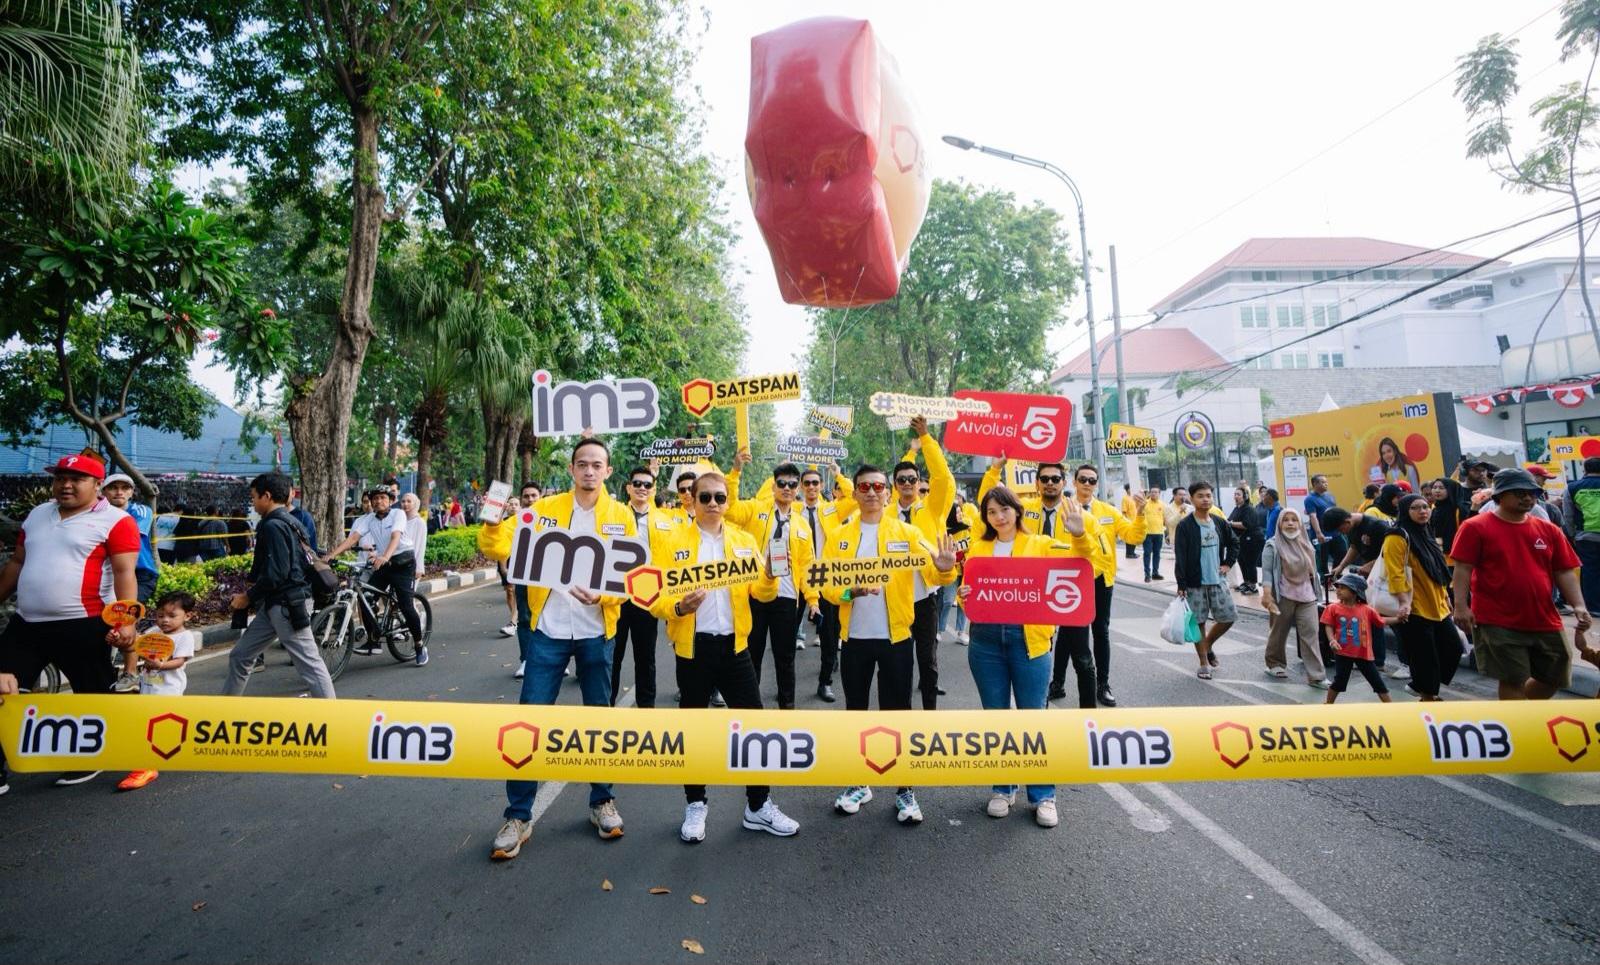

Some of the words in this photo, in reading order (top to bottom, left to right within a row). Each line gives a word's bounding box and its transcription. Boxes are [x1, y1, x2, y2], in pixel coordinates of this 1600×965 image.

[716, 374, 799, 399] SATSPAM
[537, 373, 656, 433] im3
[717, 398, 740, 406] SATUAN
[784, 391, 799, 399] SPAM
[897, 396, 942, 407] Nomor
[945, 399, 988, 410] Modus
[899, 405, 918, 414] No
[920, 408, 954, 417] More
[1403, 403, 1429, 418] im3
[643, 447, 678, 456] NOMOR
[679, 446, 713, 455] MODUS
[779, 444, 813, 453] NOMOR
[814, 447, 847, 457] MODUS
[1107, 440, 1123, 449] NO
[1125, 438, 1157, 449] MORE
[1297, 444, 1340, 458] SATSPAM
[1556, 446, 1574, 454] im3
[656, 456, 670, 464] NO
[791, 453, 806, 461] NO
[1015, 465, 1038, 485] im
[512, 512, 647, 594] im3
[667, 557, 758, 587] SATSPAM
[832, 561, 879, 573] Nomor
[882, 556, 926, 569] Modus
[668, 587, 693, 596] SATUAN
[711, 579, 728, 588] SCAM
[743, 575, 759, 584] SPAM
[833, 575, 852, 587] No
[855, 573, 889, 585] More
[978, 577, 1020, 585] POWERED
[21, 708, 105, 753] im3
[194, 720, 328, 746] SATSPAM
[371, 714, 454, 761] im3
[1259, 725, 1391, 751] SATSPAM
[1423, 714, 1512, 760] im3
[546, 728, 685, 755] SATSPAM
[731, 722, 815, 768] im3
[909, 731, 1047, 757] SATSPAM
[1087, 721, 1171, 767] im3
[193, 747, 229, 757] SATUAN
[230, 748, 252, 757] ANTI
[254, 748, 280, 758] SCAM
[281, 749, 301, 758] DAN
[303, 749, 327, 759] SPAM
[1262, 753, 1297, 764] SATUAN
[1298, 753, 1320, 763] ANTI
[1321, 753, 1346, 763] SCAM
[1347, 752, 1367, 762] DAN
[1368, 751, 1392, 762] SPAM
[545, 756, 582, 767] SATUAN
[584, 757, 606, 767] ANTI
[608, 758, 635, 768] SCAM
[637, 758, 658, 768] DAN
[660, 758, 685, 768] SPAM
[909, 760, 946, 770] SATUAN
[948, 760, 971, 770] ANTI
[973, 760, 999, 769] SCAM
[1001, 760, 1021, 769] DAN
[1023, 759, 1048, 769] SPAM
